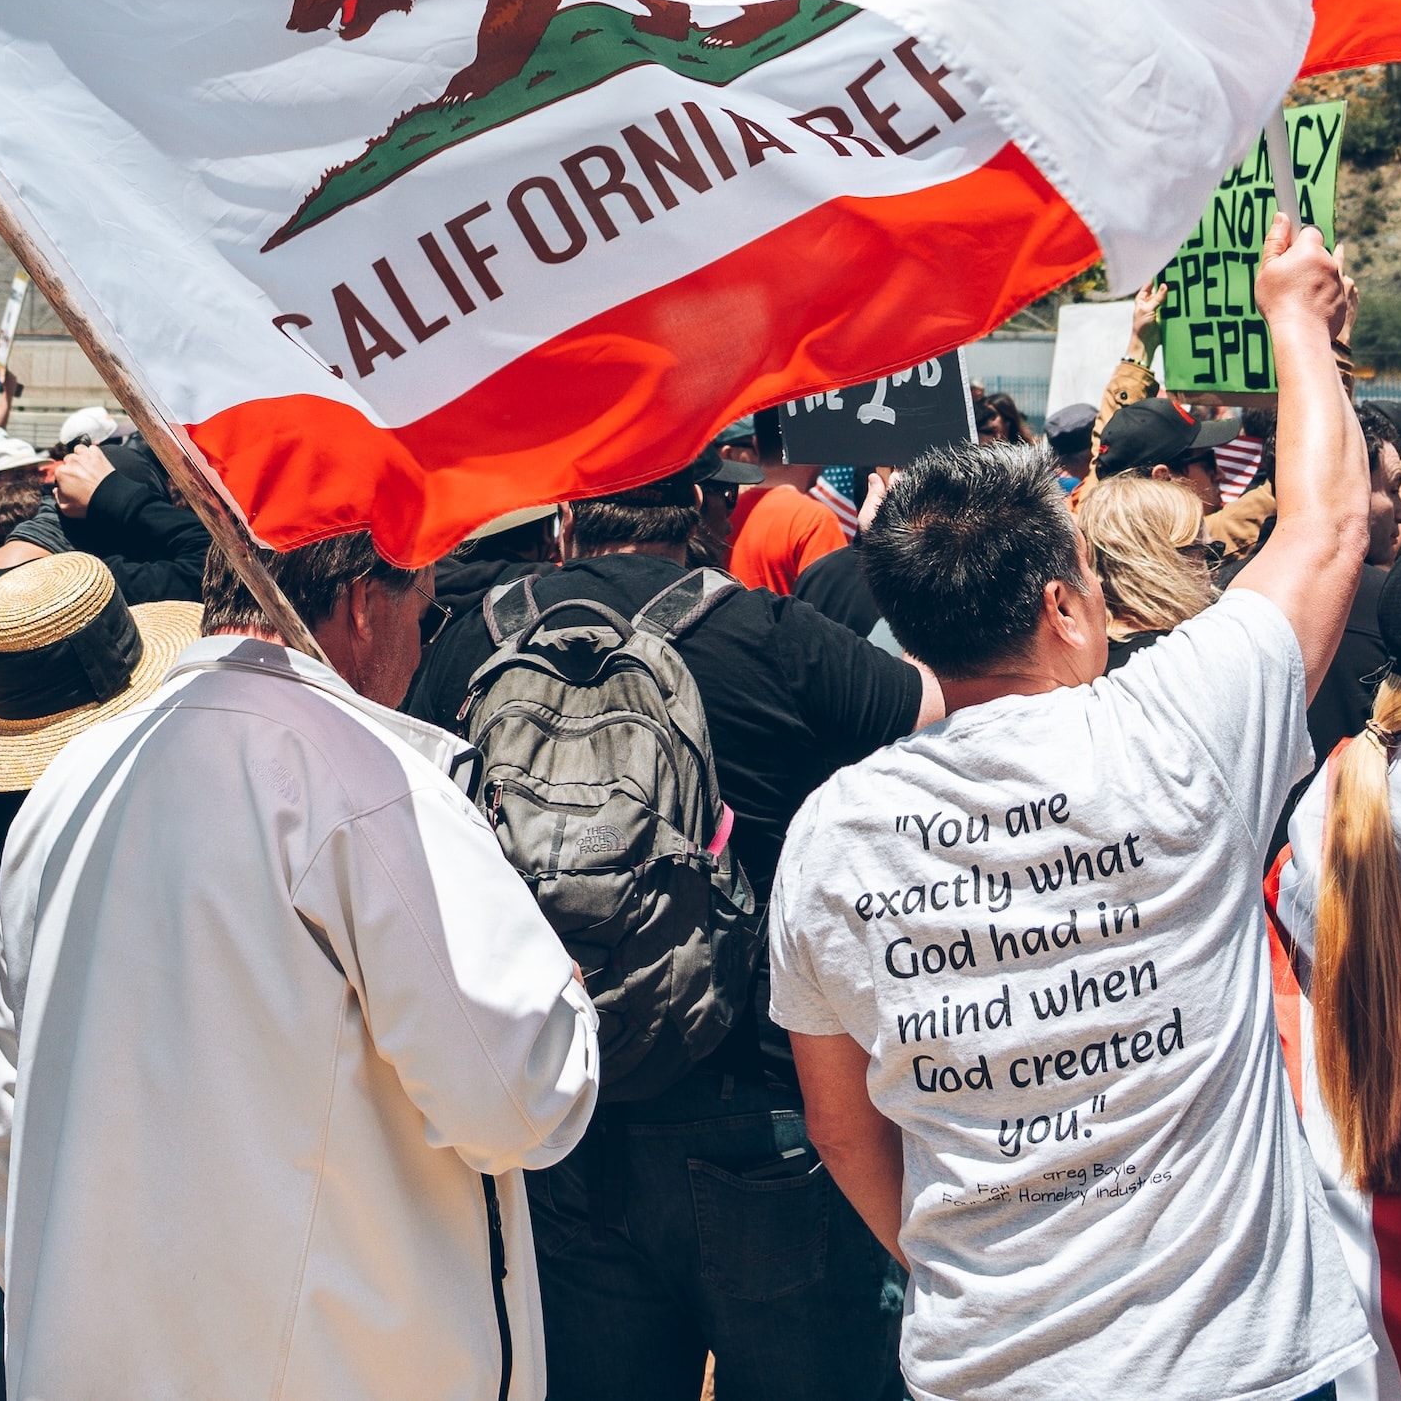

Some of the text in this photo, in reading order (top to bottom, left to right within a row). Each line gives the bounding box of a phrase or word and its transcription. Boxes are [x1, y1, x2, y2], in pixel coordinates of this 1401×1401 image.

[1214, 188, 1275, 248] NOT
[1157, 250, 1260, 319] SPECT
[1189, 319, 1278, 390] SPO
[576, 835, 607, 846] ORTH
[587, 826, 607, 836] THE
[1004, 792, 1071, 838] are
[580, 844, 608, 854] FACE
[855, 832, 1145, 922] exactly what
[885, 900, 1141, 979] God had in
[898, 958, 1158, 1044] mind when
[913, 1008, 1185, 1093] God created
[1019, 1187, 1089, 1206] Homeboy
[1043, 1167, 1087, 1186] Greg
[1093, 1162, 1137, 1182] Boyle
